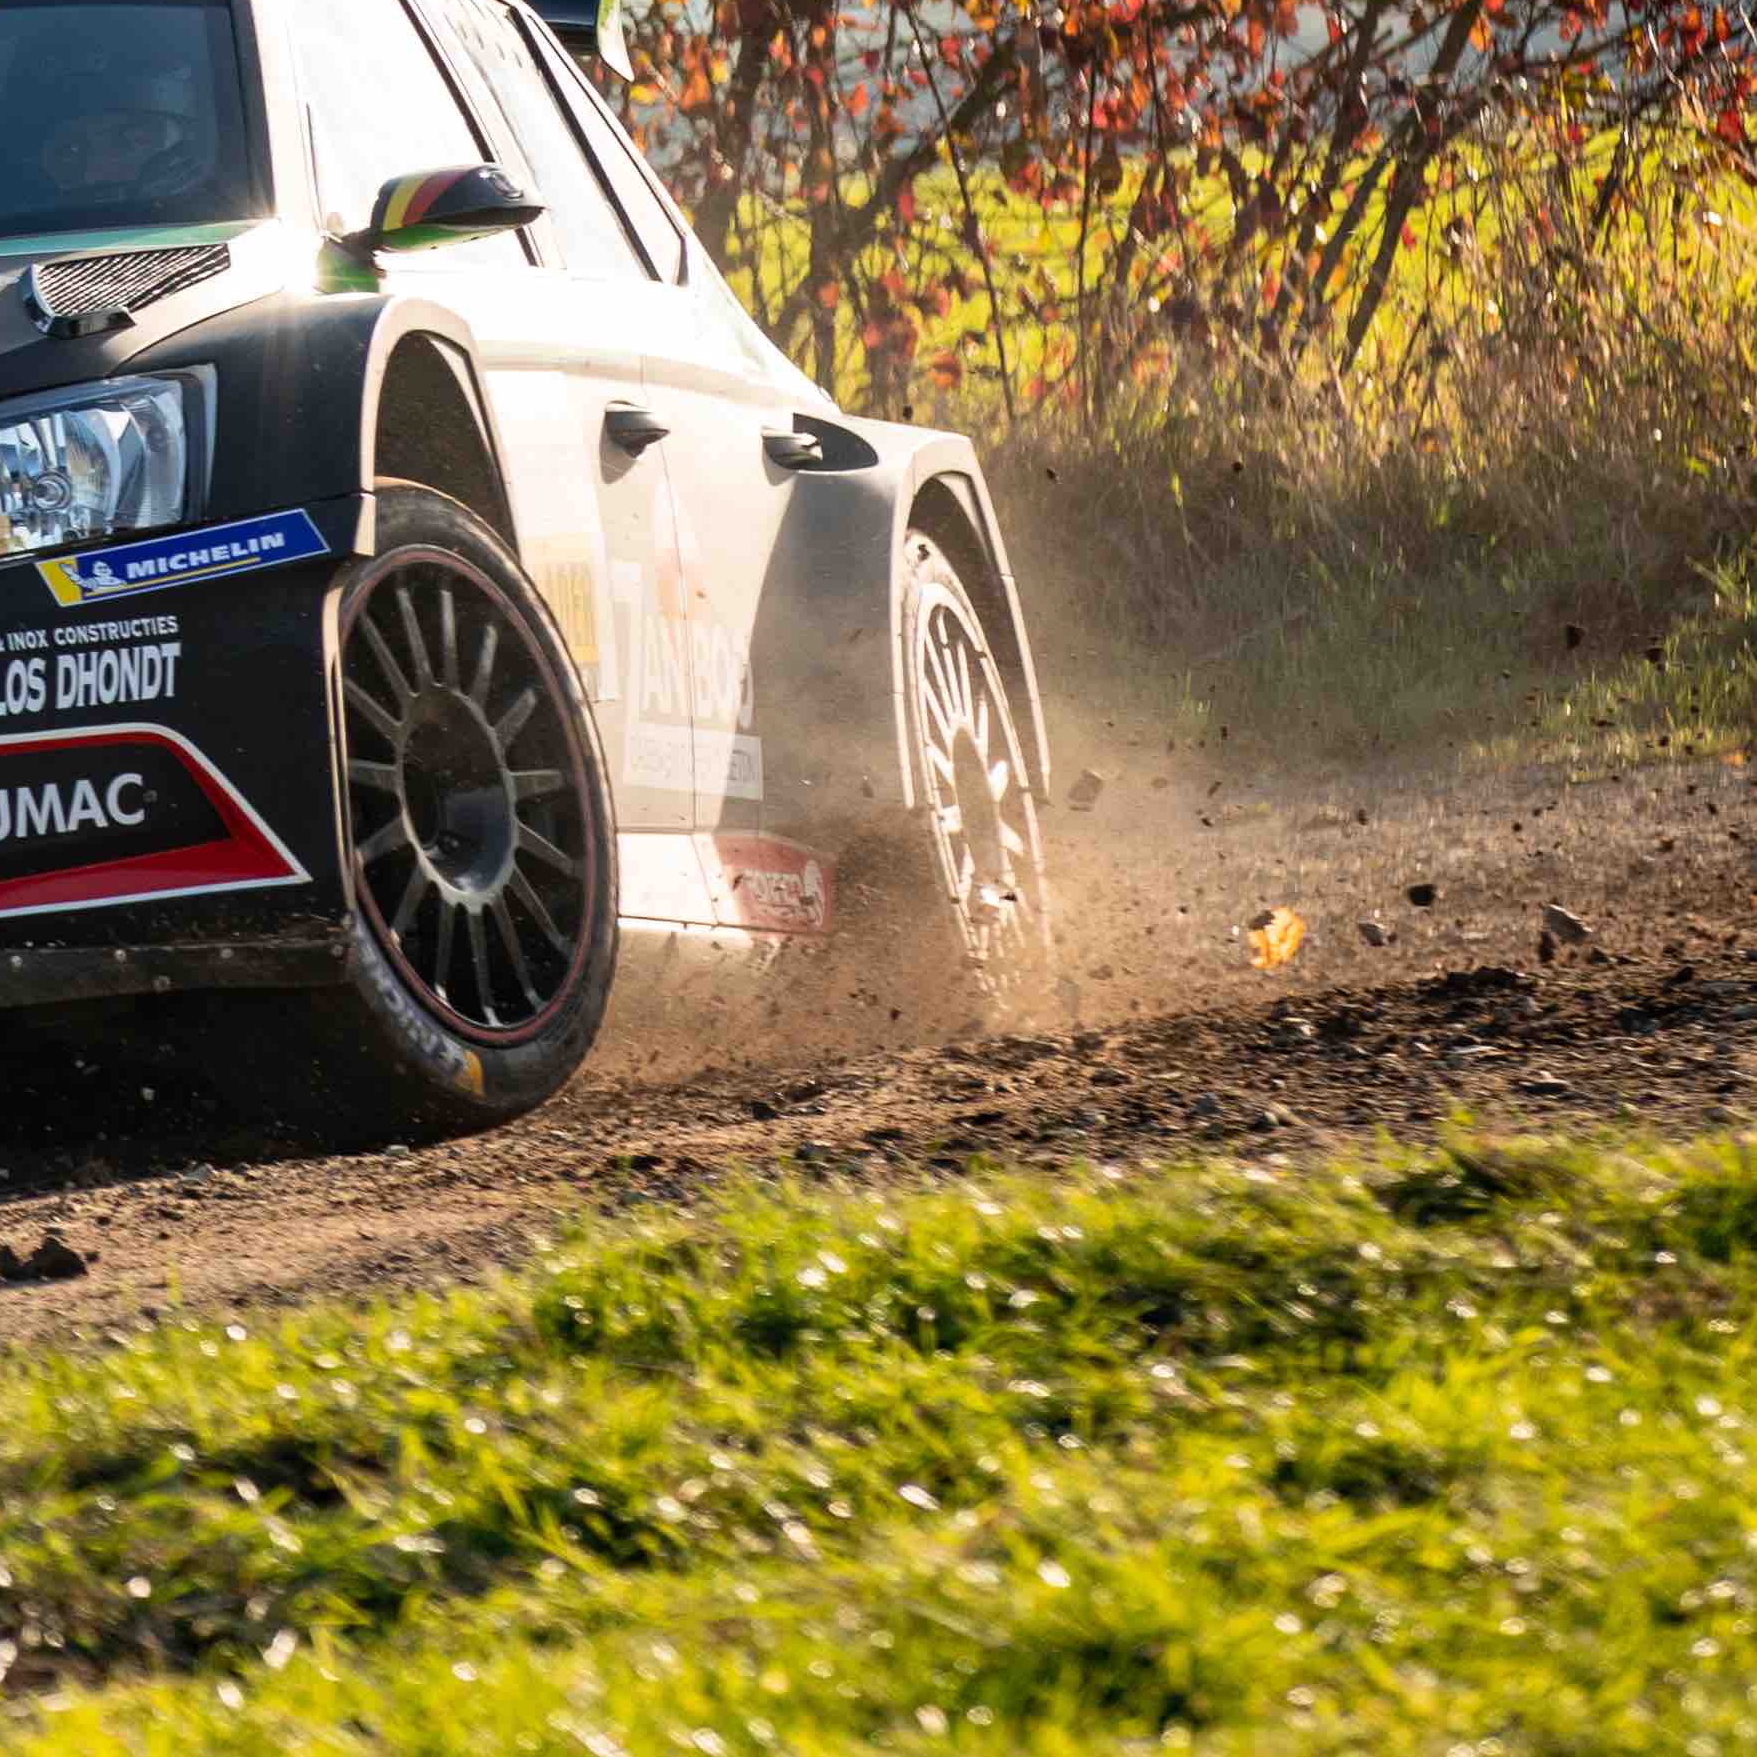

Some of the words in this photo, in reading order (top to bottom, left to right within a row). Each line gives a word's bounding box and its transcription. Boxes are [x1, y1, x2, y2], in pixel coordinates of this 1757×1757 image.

[125, 531, 286, 580] MICHELIN
[7, 629, 49, 650] INOX
[53, 615, 179, 646] CONSTRUCTIES
[56, 642, 181, 710] DHONDT
